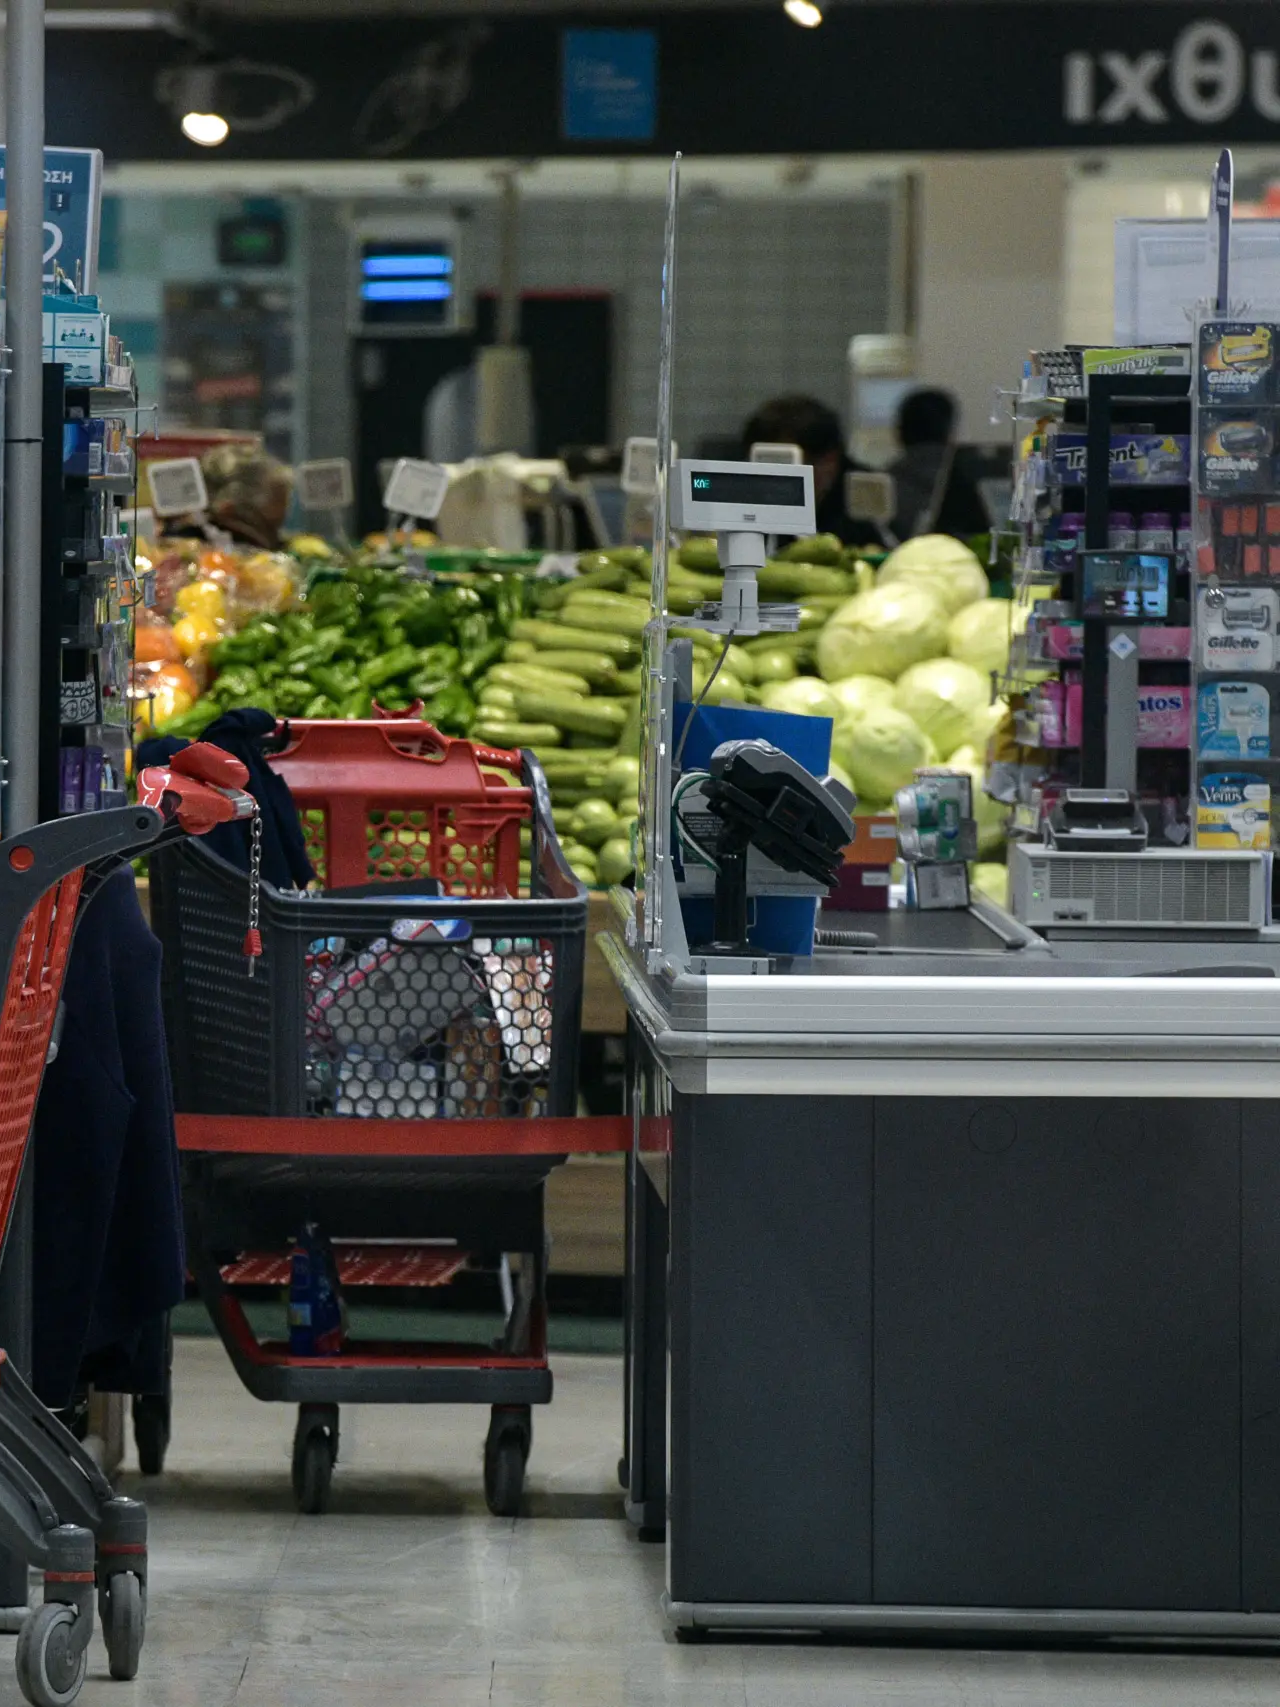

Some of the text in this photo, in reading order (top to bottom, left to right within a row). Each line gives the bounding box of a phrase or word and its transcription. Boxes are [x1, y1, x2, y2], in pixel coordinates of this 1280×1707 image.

[1207, 371, 1260, 384] Gillette
[1055, 441, 1144, 470] Trent
[1206, 457, 1259, 471] Gillette
[1208, 637, 1260, 649] Gillette
[1137, 694, 1184, 712] ntos
[1200, 786, 1242, 803] Venus
